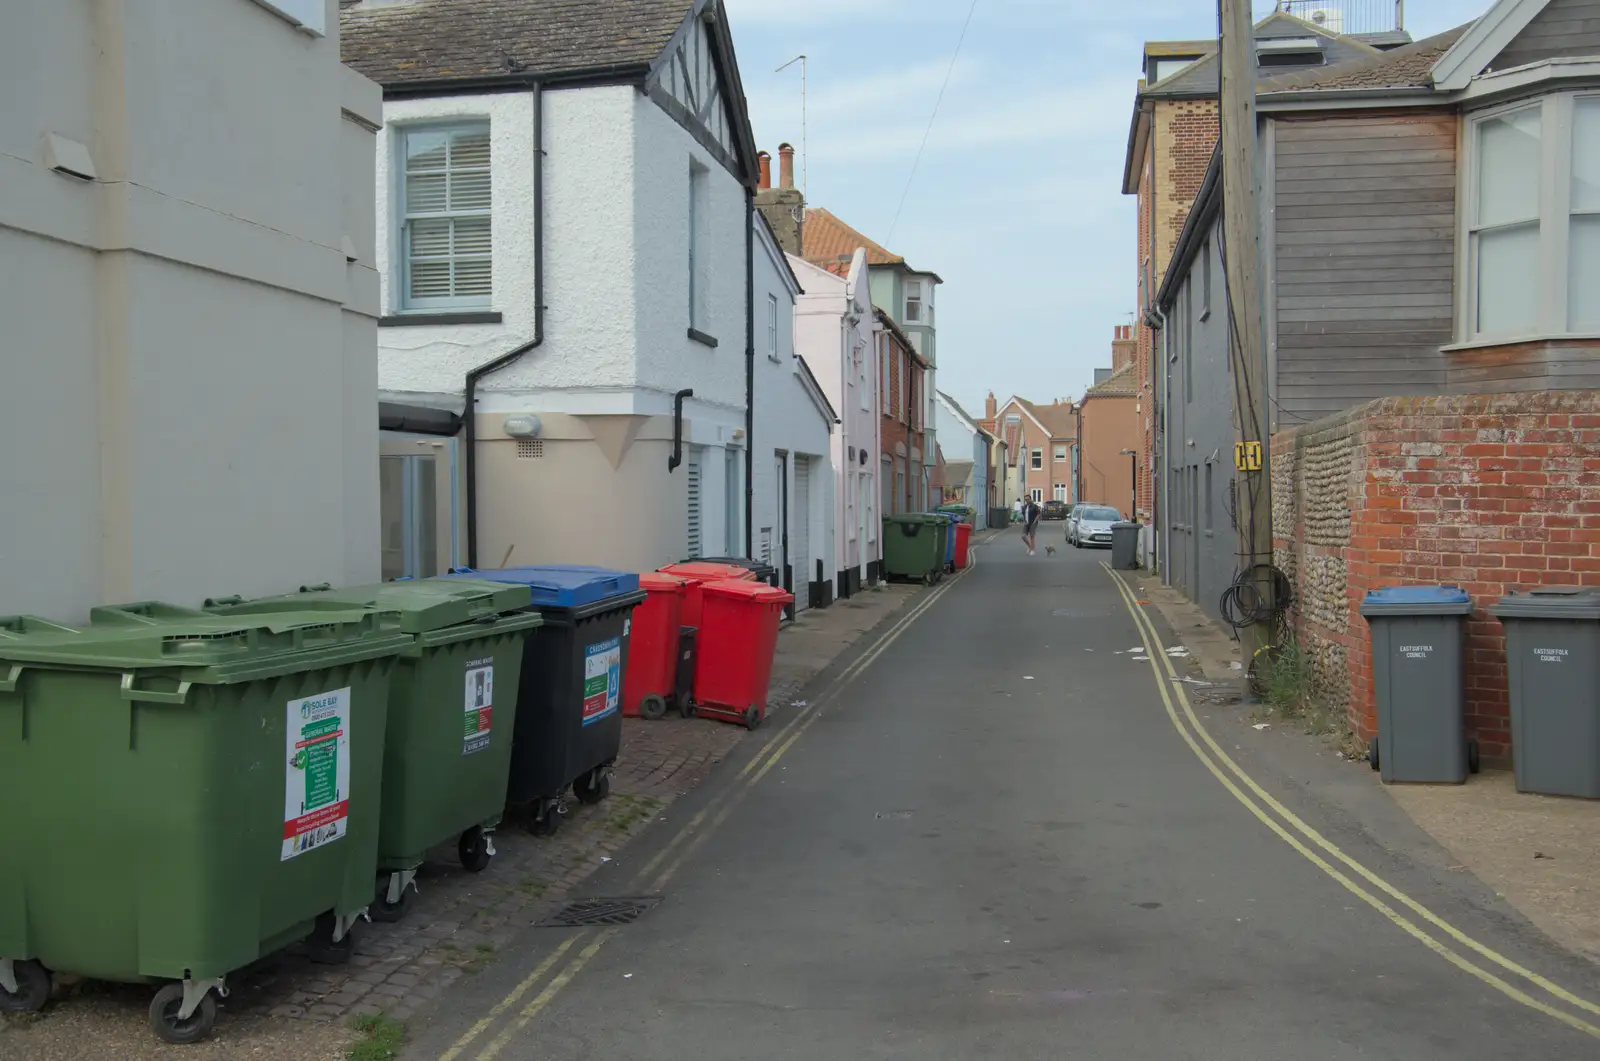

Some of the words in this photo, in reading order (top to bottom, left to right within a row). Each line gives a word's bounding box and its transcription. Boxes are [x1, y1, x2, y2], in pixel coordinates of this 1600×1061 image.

[1239, 445, 1258, 467] H
[311, 699, 326, 710] SOLE
[327, 696, 338, 705] BAY
[305, 728, 324, 739] GENERAL
[324, 723, 337, 733] WASTE
